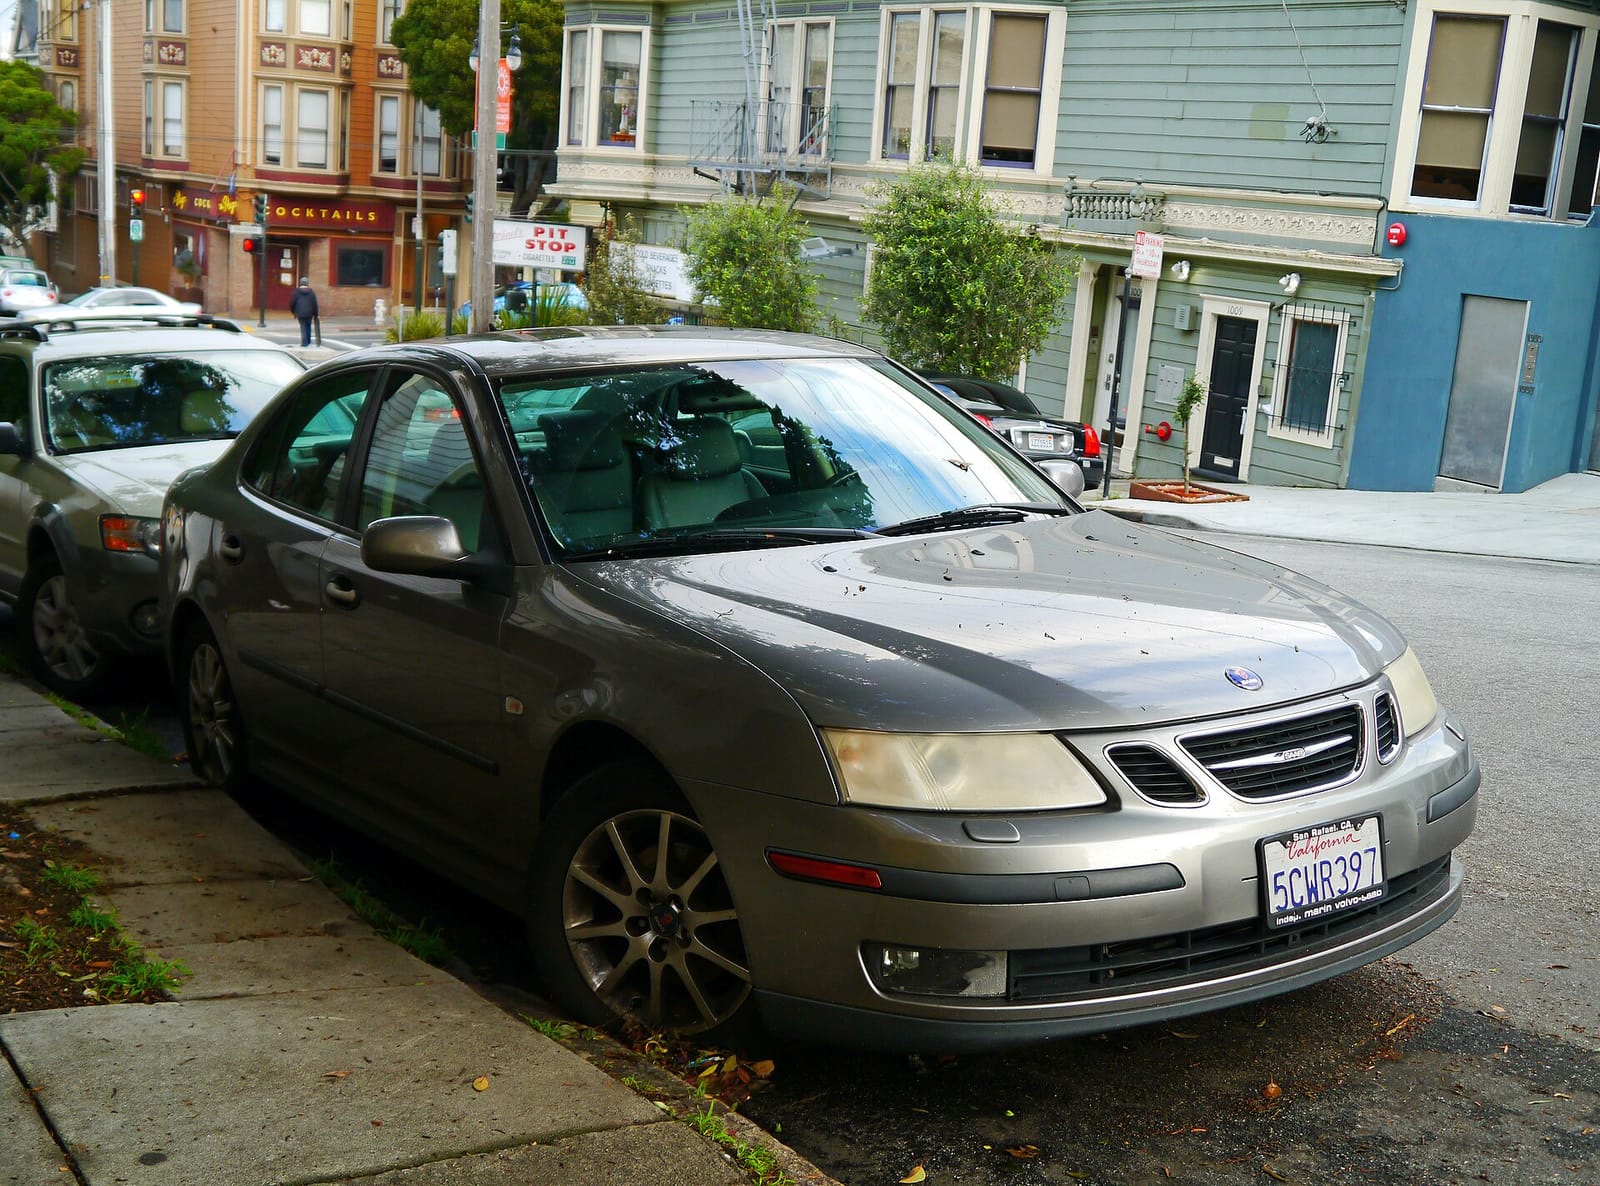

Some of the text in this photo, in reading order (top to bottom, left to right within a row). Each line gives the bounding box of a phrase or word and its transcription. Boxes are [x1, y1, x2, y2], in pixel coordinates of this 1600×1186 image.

[533, 226, 569, 240] PIT
[525, 239, 576, 253] STOP
[1226, 305, 1244, 316] 1009
[1293, 832, 1309, 841] San
[1287, 833, 1361, 860] California
[1273, 847, 1377, 912] 5CWR397
